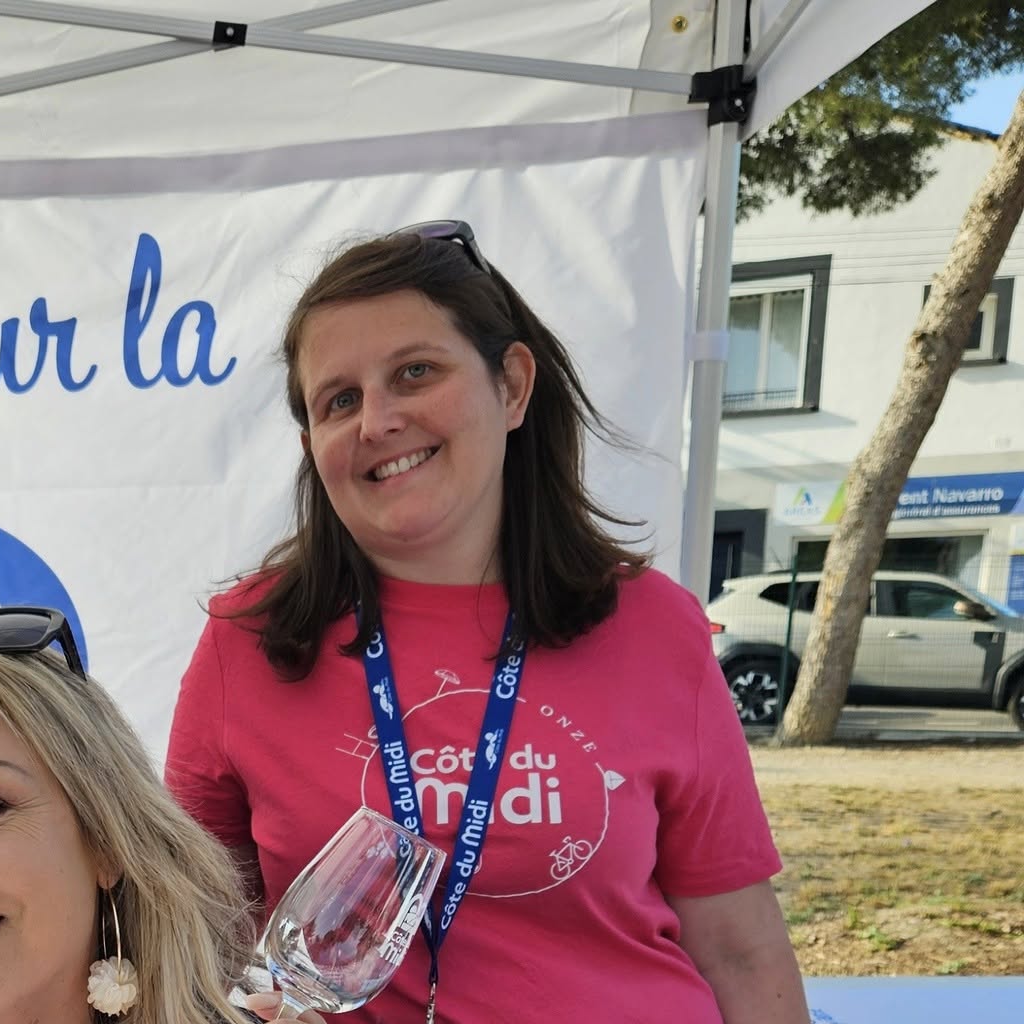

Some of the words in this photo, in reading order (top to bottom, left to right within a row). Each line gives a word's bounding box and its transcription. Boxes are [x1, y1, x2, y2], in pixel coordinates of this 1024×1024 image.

[122, 232, 237, 389] la
[898, 489, 929, 505] ent
[932, 487, 1004, 503] Navarro
[496, 655, 521, 700] Côte
[540, 704, 597, 753] ONZE
[410, 745, 476, 774] Côt
[510, 744, 556, 770] du
[394, 787, 415, 812] du
[415, 772, 562, 825] Mdi
[441, 882, 467, 930] Côte
[461, 850, 477, 877] du
